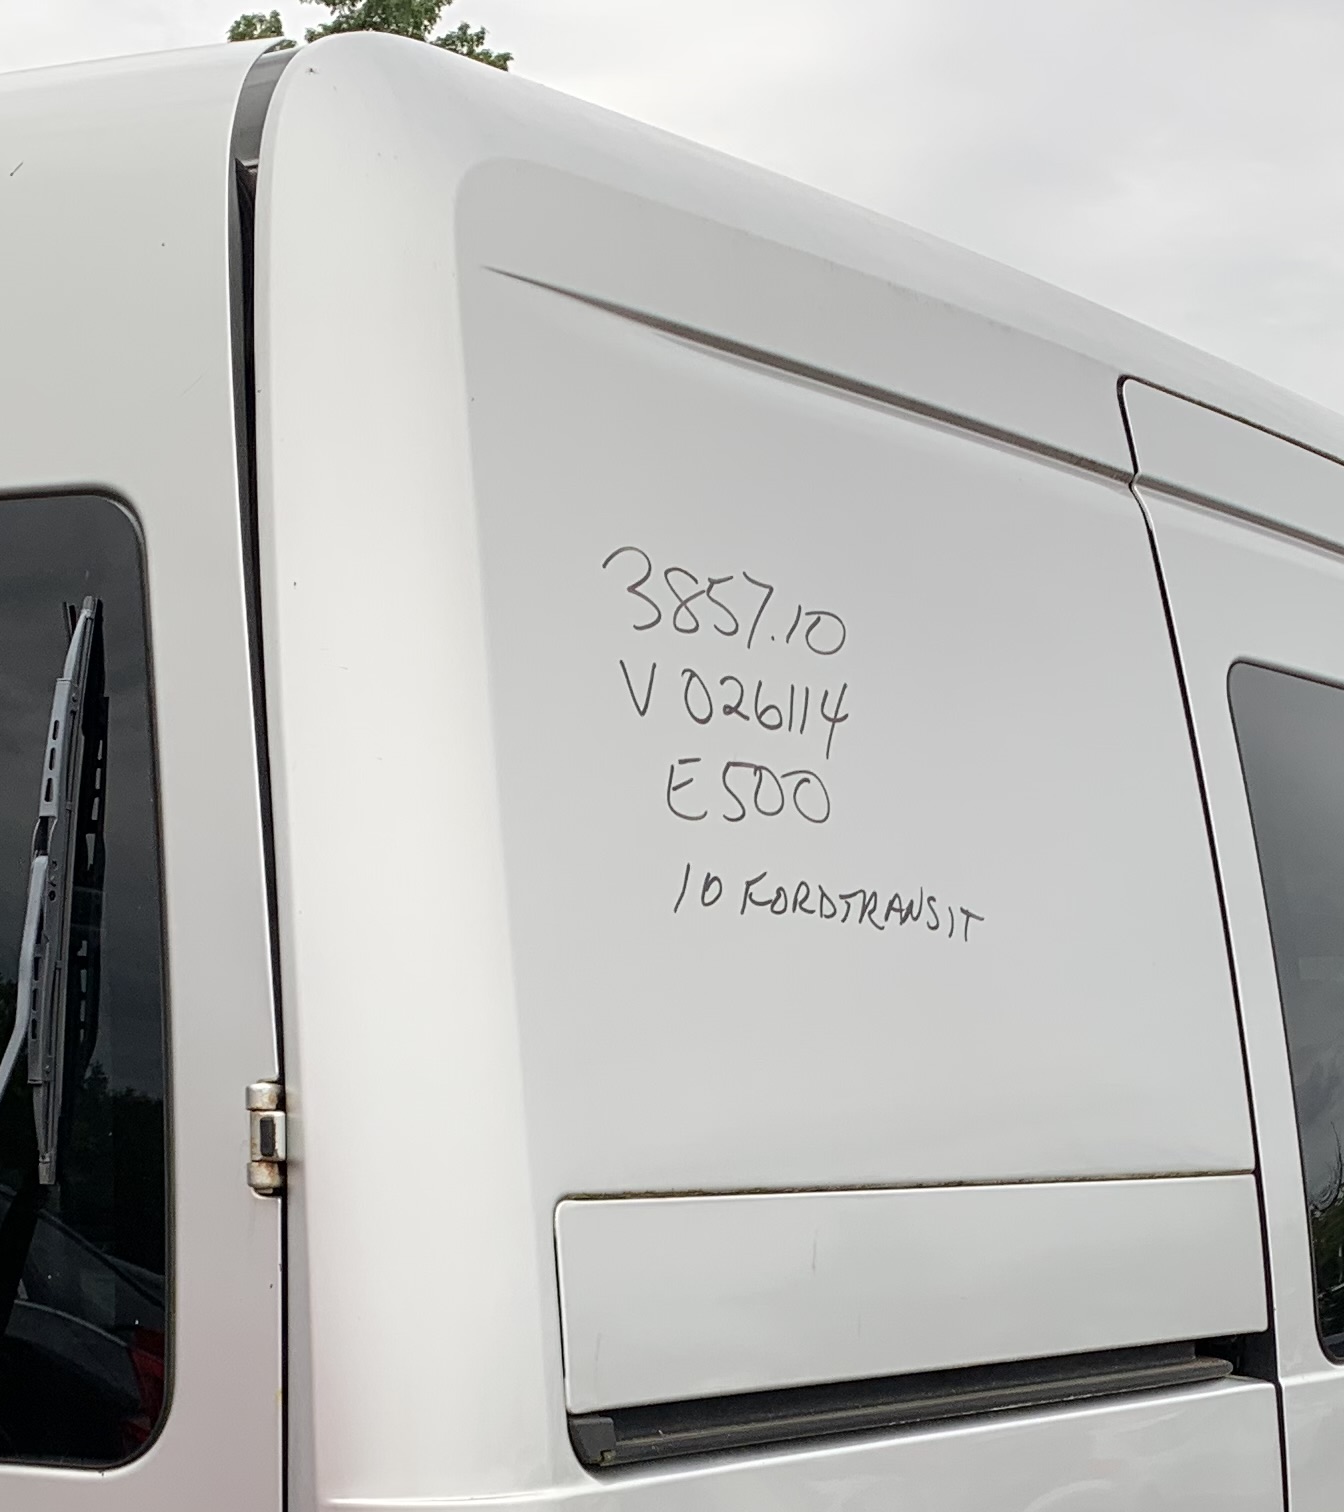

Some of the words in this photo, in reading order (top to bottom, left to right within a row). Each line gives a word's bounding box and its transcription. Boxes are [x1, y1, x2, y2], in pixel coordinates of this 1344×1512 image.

[603, 546, 846, 655] 3857.10
[619, 660, 657, 716] V
[681, 668, 849, 759] 026114
